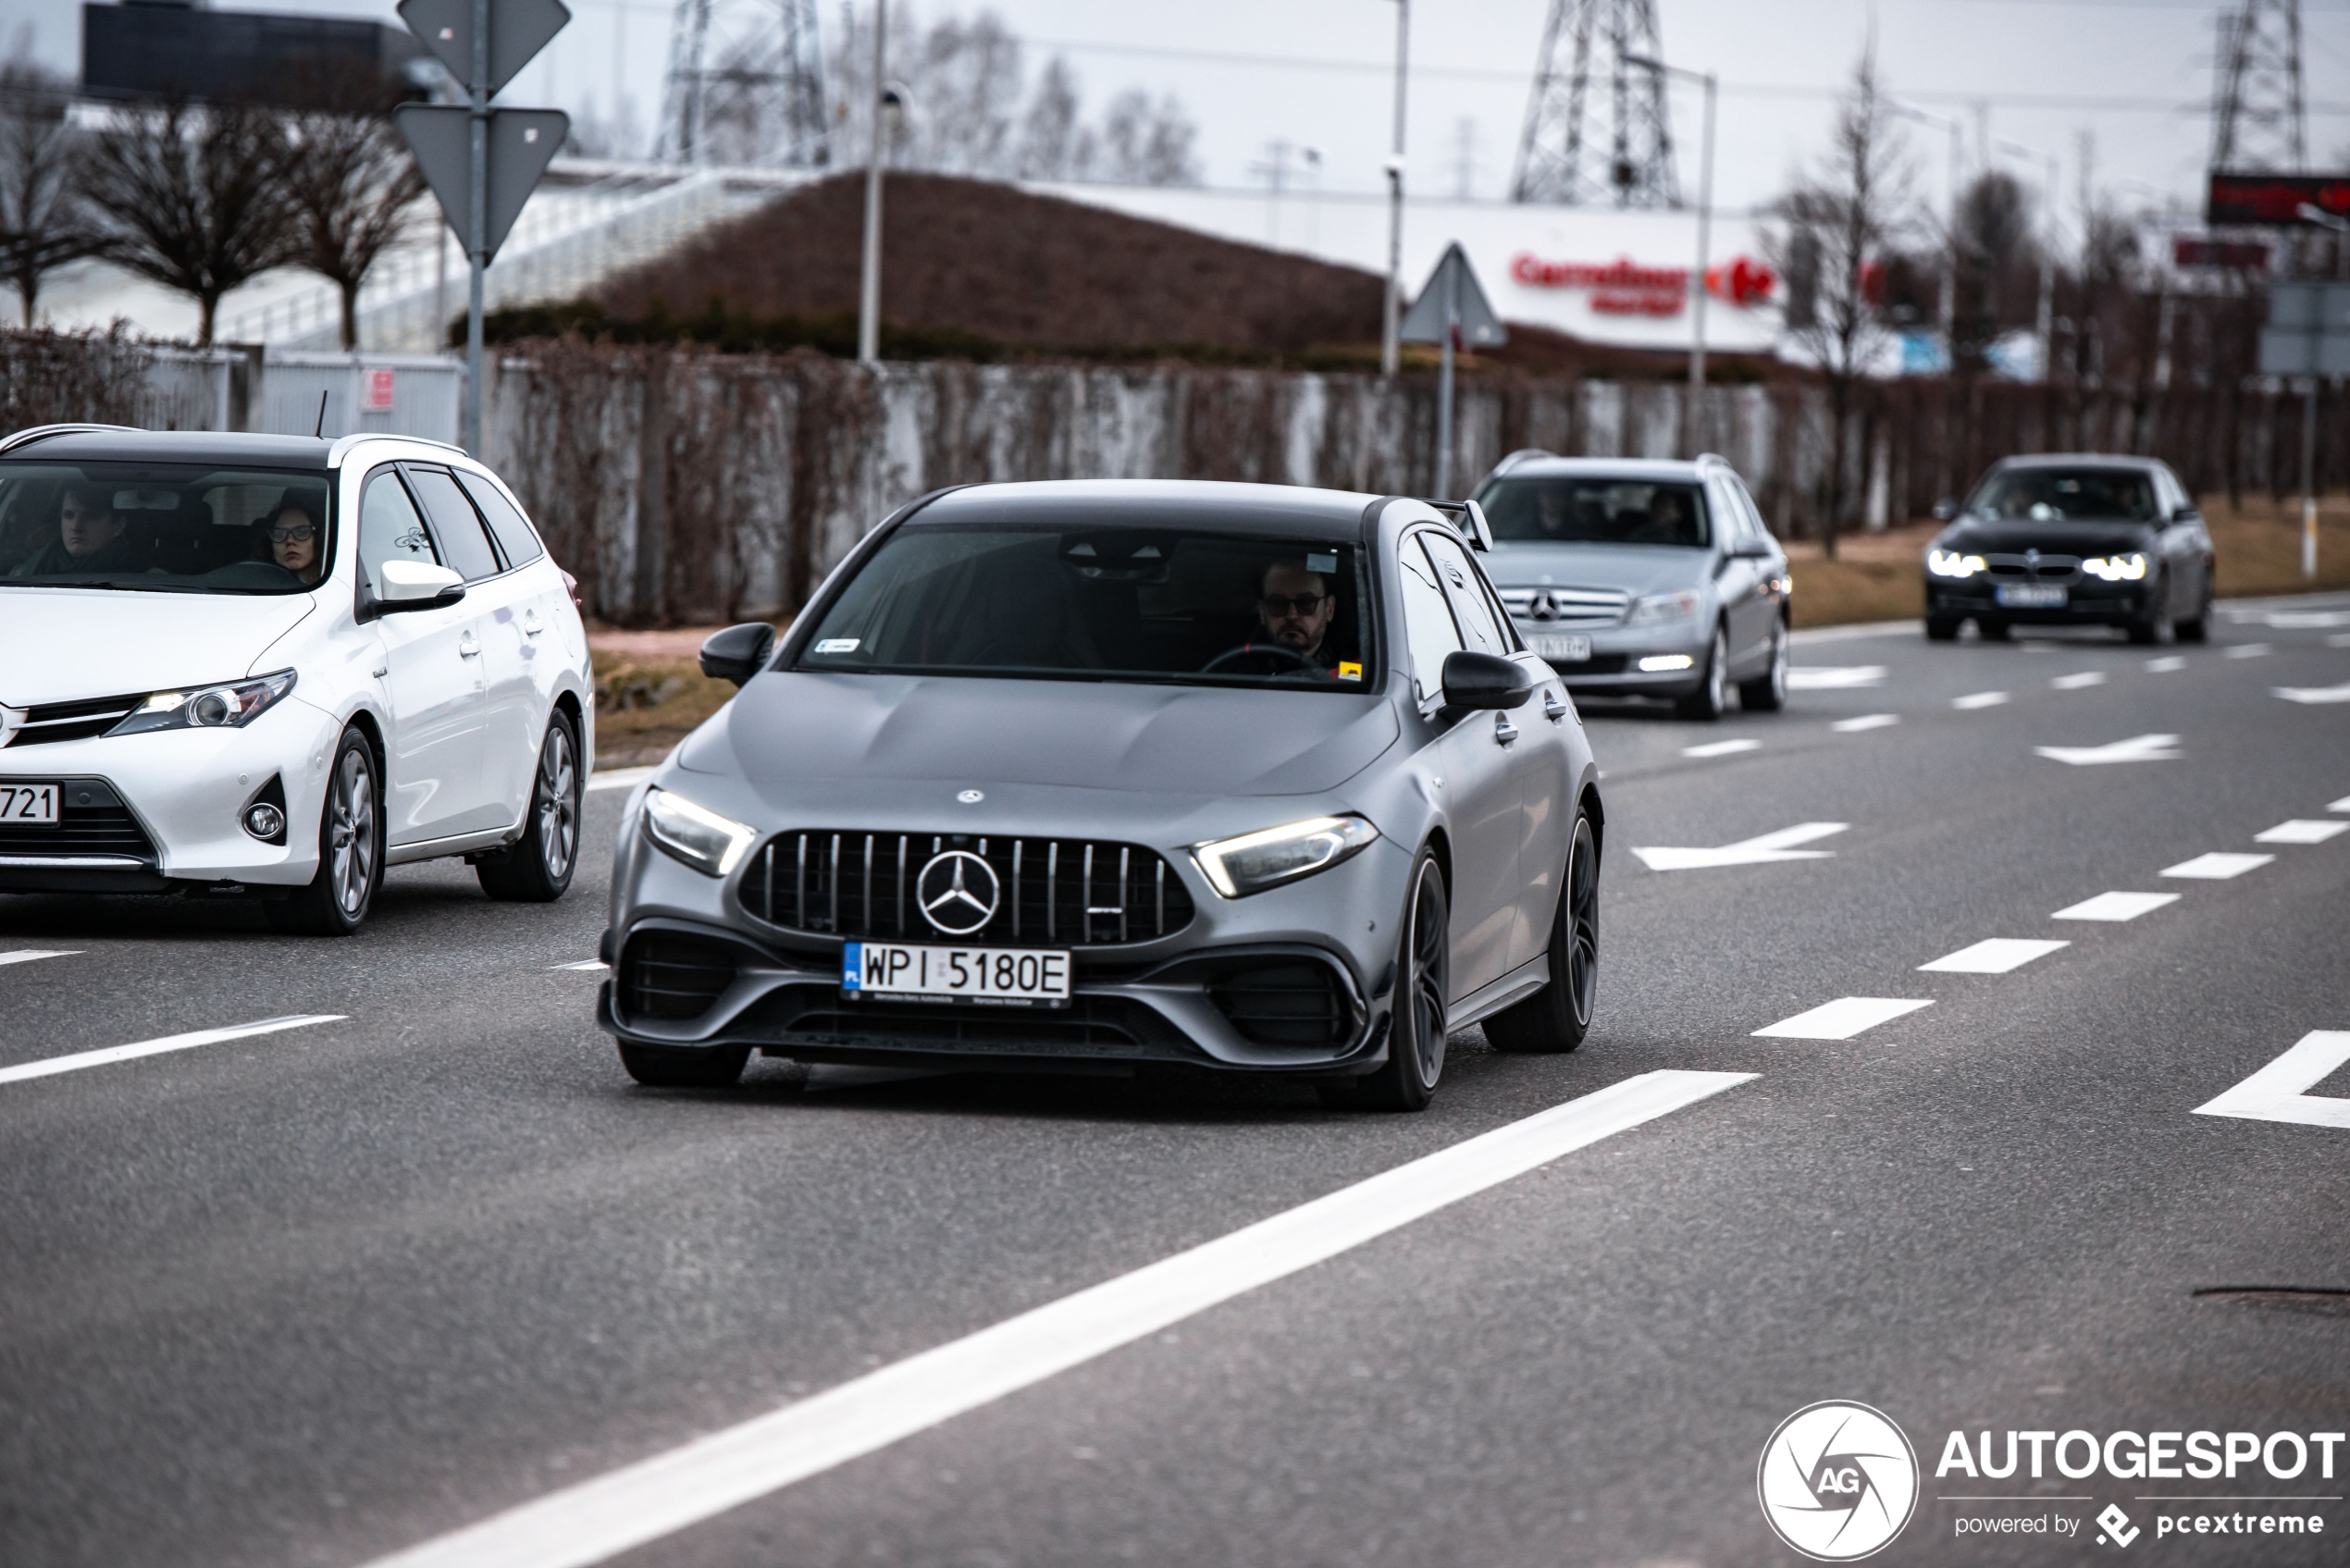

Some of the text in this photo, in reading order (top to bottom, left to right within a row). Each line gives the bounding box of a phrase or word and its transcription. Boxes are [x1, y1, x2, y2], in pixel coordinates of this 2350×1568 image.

[0, 787, 51, 819] 721
[845, 970, 860, 982] PL
[865, 948, 1064, 993] WPI 5180E
